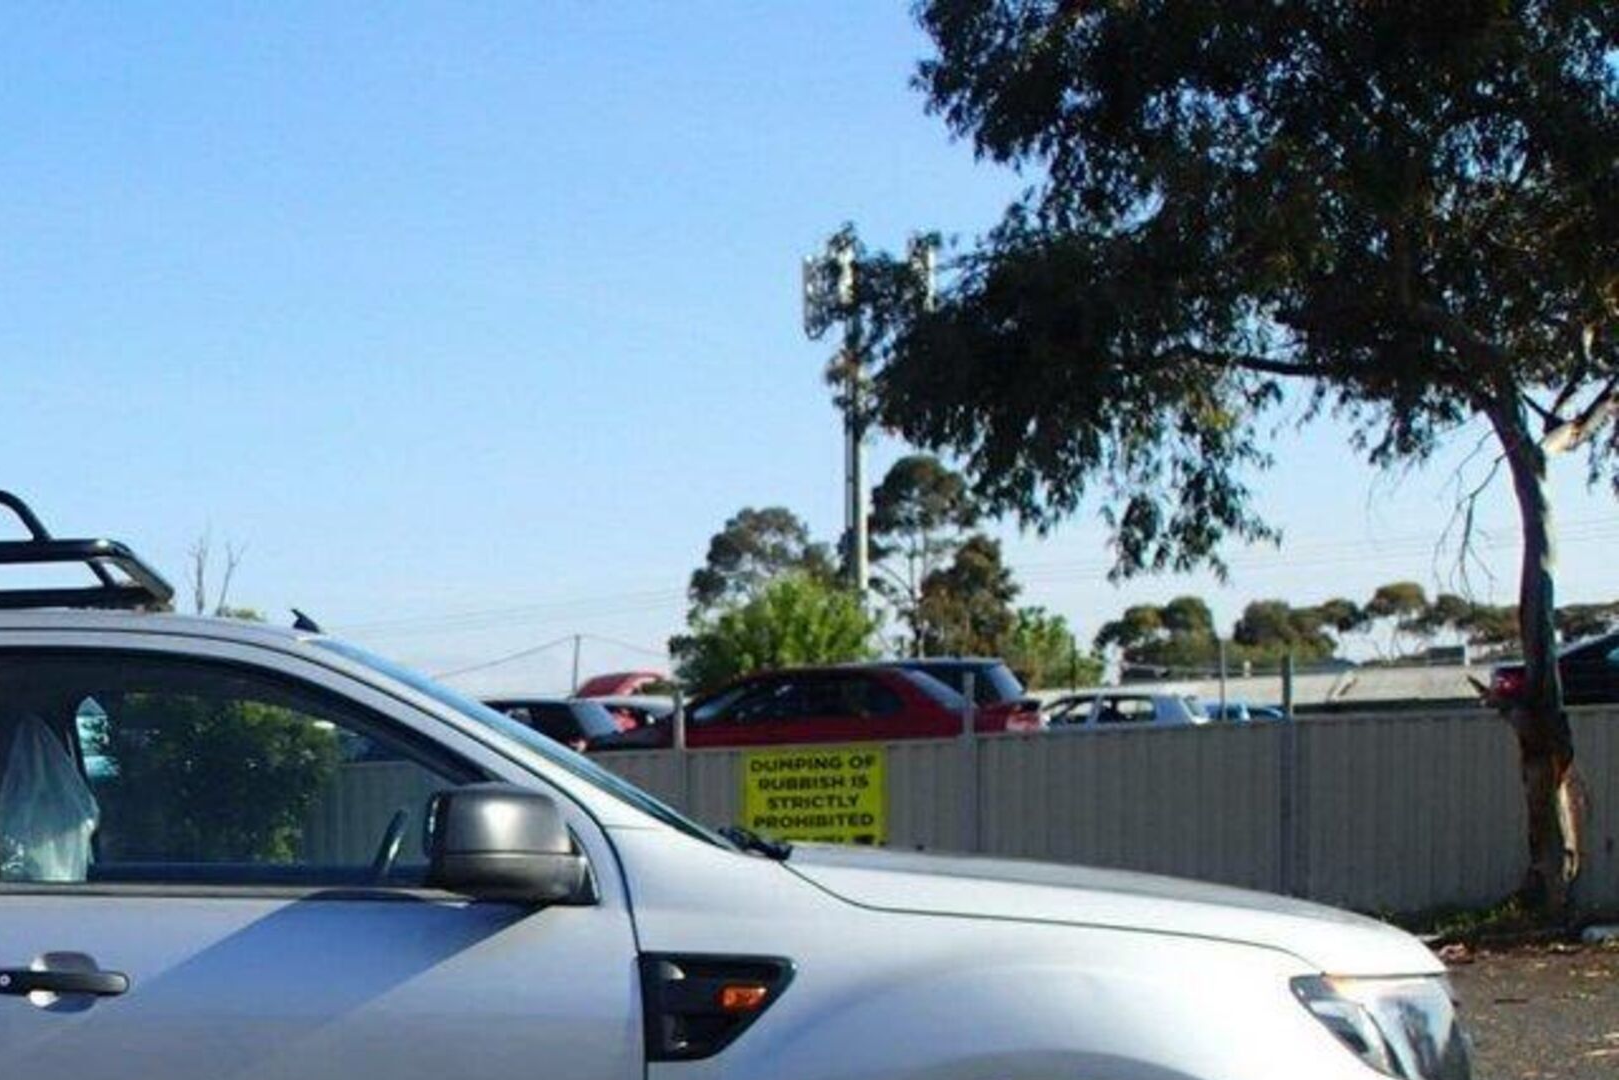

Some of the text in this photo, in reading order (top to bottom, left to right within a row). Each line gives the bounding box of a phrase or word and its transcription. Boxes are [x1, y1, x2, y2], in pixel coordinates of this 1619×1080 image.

[751, 755, 874, 773] DUMPING OF
[758, 775, 869, 790] RUBBISH IS
[768, 794, 859, 809] STRICTLY
[753, 814, 873, 828] PROHIBITED
